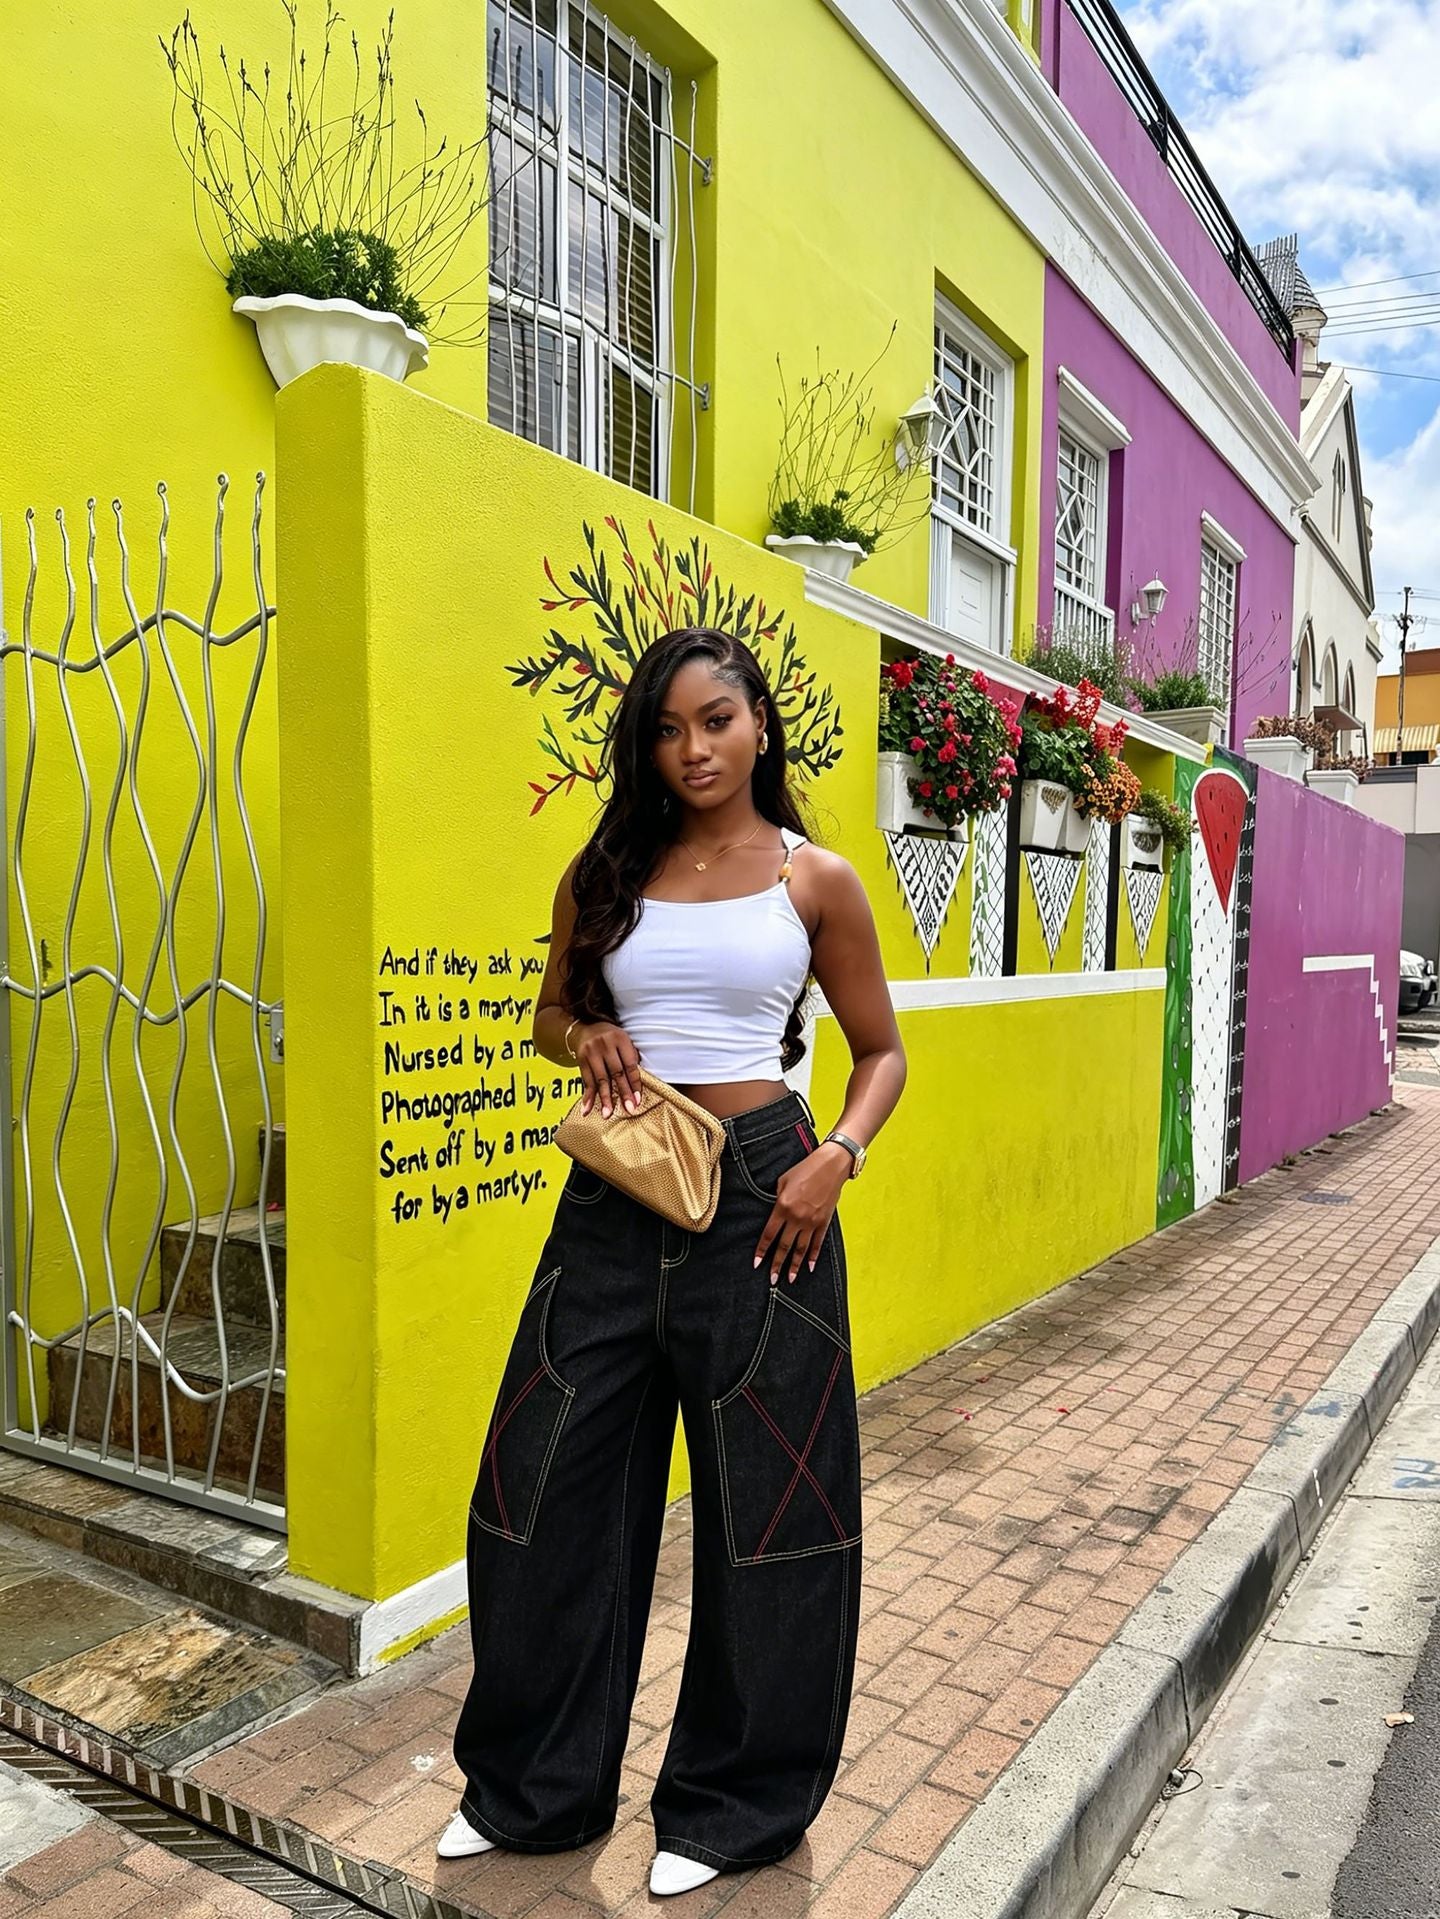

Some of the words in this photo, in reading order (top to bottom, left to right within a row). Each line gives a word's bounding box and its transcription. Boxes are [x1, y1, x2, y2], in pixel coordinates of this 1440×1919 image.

[379, 946, 419, 976] And
[426, 947, 438, 975] if
[443, 948, 478, 984] they
[488, 947, 512, 975] ask
[379, 991, 406, 1026] In
[416, 995, 430, 1022] it
[438, 993, 453, 1022] is
[459, 998, 470, 1020] a
[385, 1034, 463, 1075] Nursed
[474, 1034, 496, 1070] by
[501, 1040, 514, 1061] a
[381, 1073, 515, 1130] Photographed
[526, 1072, 546, 1112] by
[551, 1078, 563, 1100] a
[379, 1140, 429, 1178] Sent
[435, 1128, 466, 1169] off
[474, 1127, 497, 1167] by
[504, 1131, 515, 1155] a
[391, 1190, 423, 1224] for
[431, 1183, 454, 1224] by
[456, 1186, 469, 1210] a
[477, 1169, 547, 1205] martyr.
